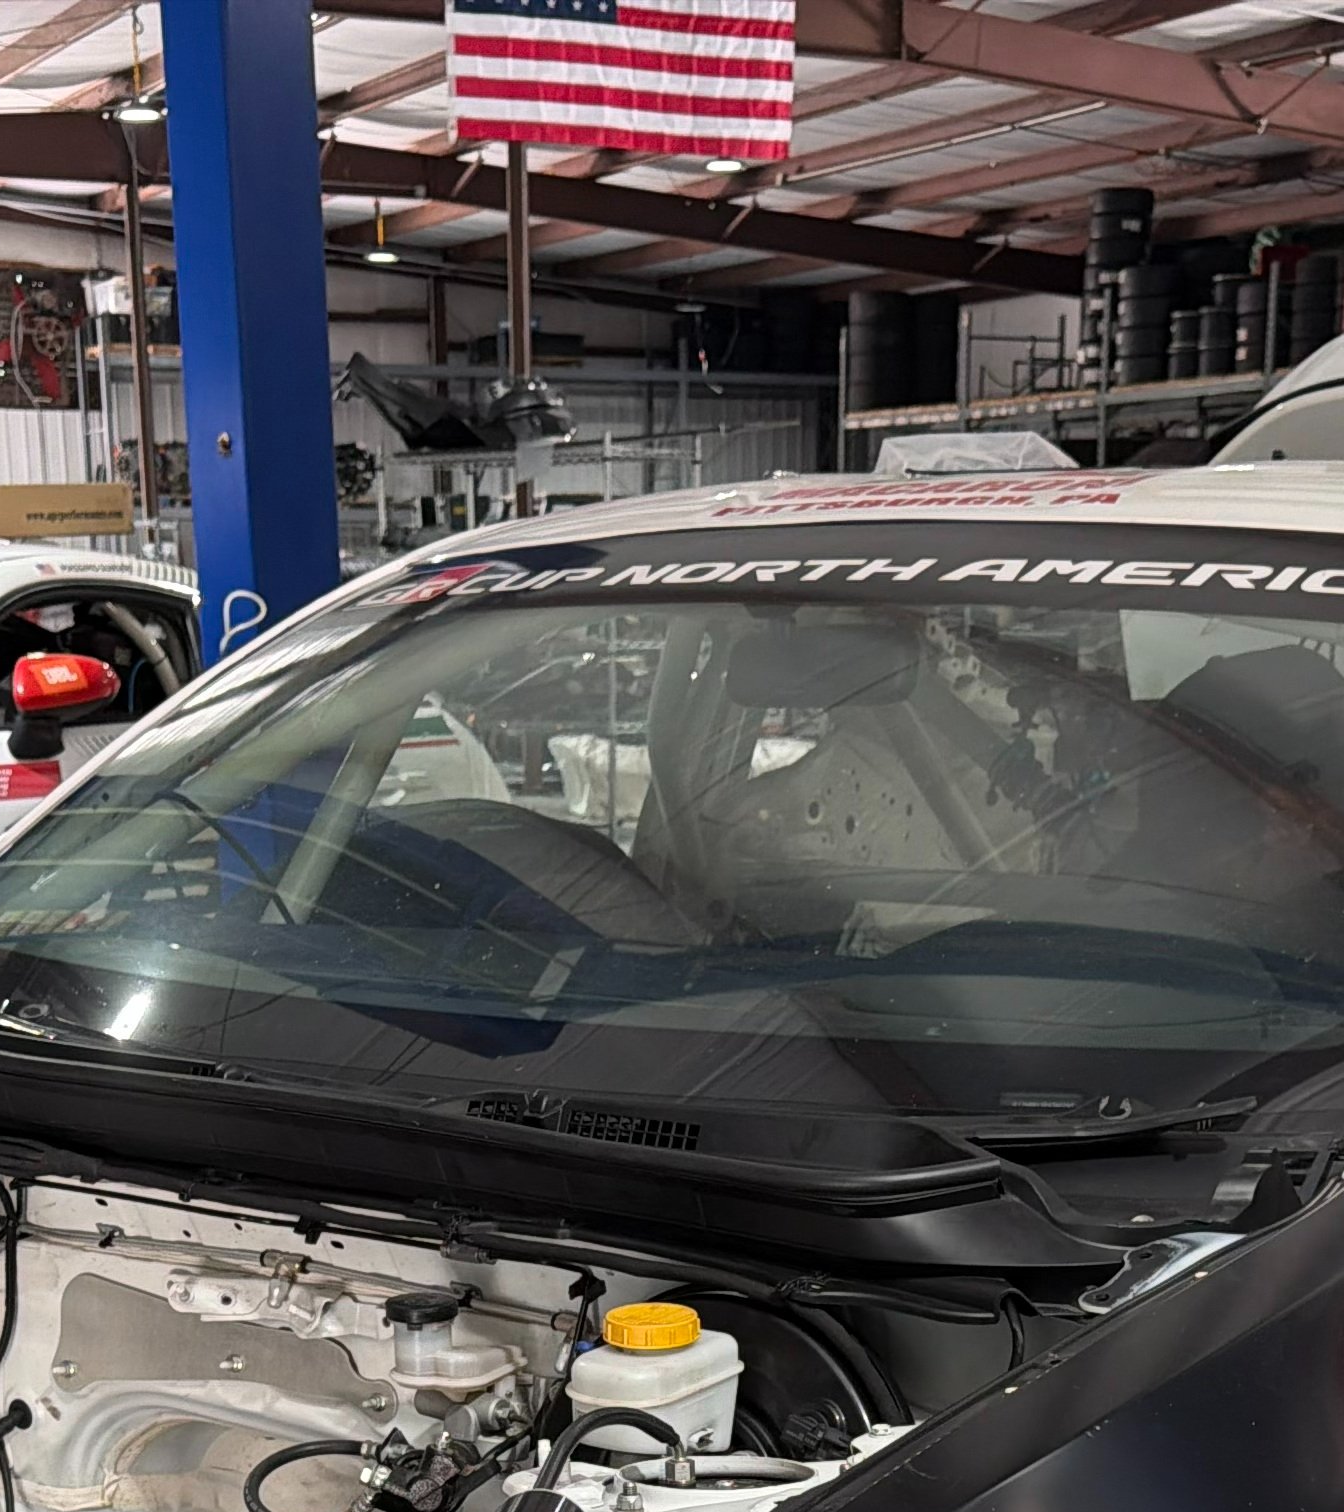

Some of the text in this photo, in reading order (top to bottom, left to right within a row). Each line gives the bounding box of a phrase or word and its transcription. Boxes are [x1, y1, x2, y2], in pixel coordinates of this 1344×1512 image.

[711, 493, 1122, 518] PITTSBURGH, PA
[446, 567, 606, 596] CUP
[599, 558, 940, 588] NORTH
